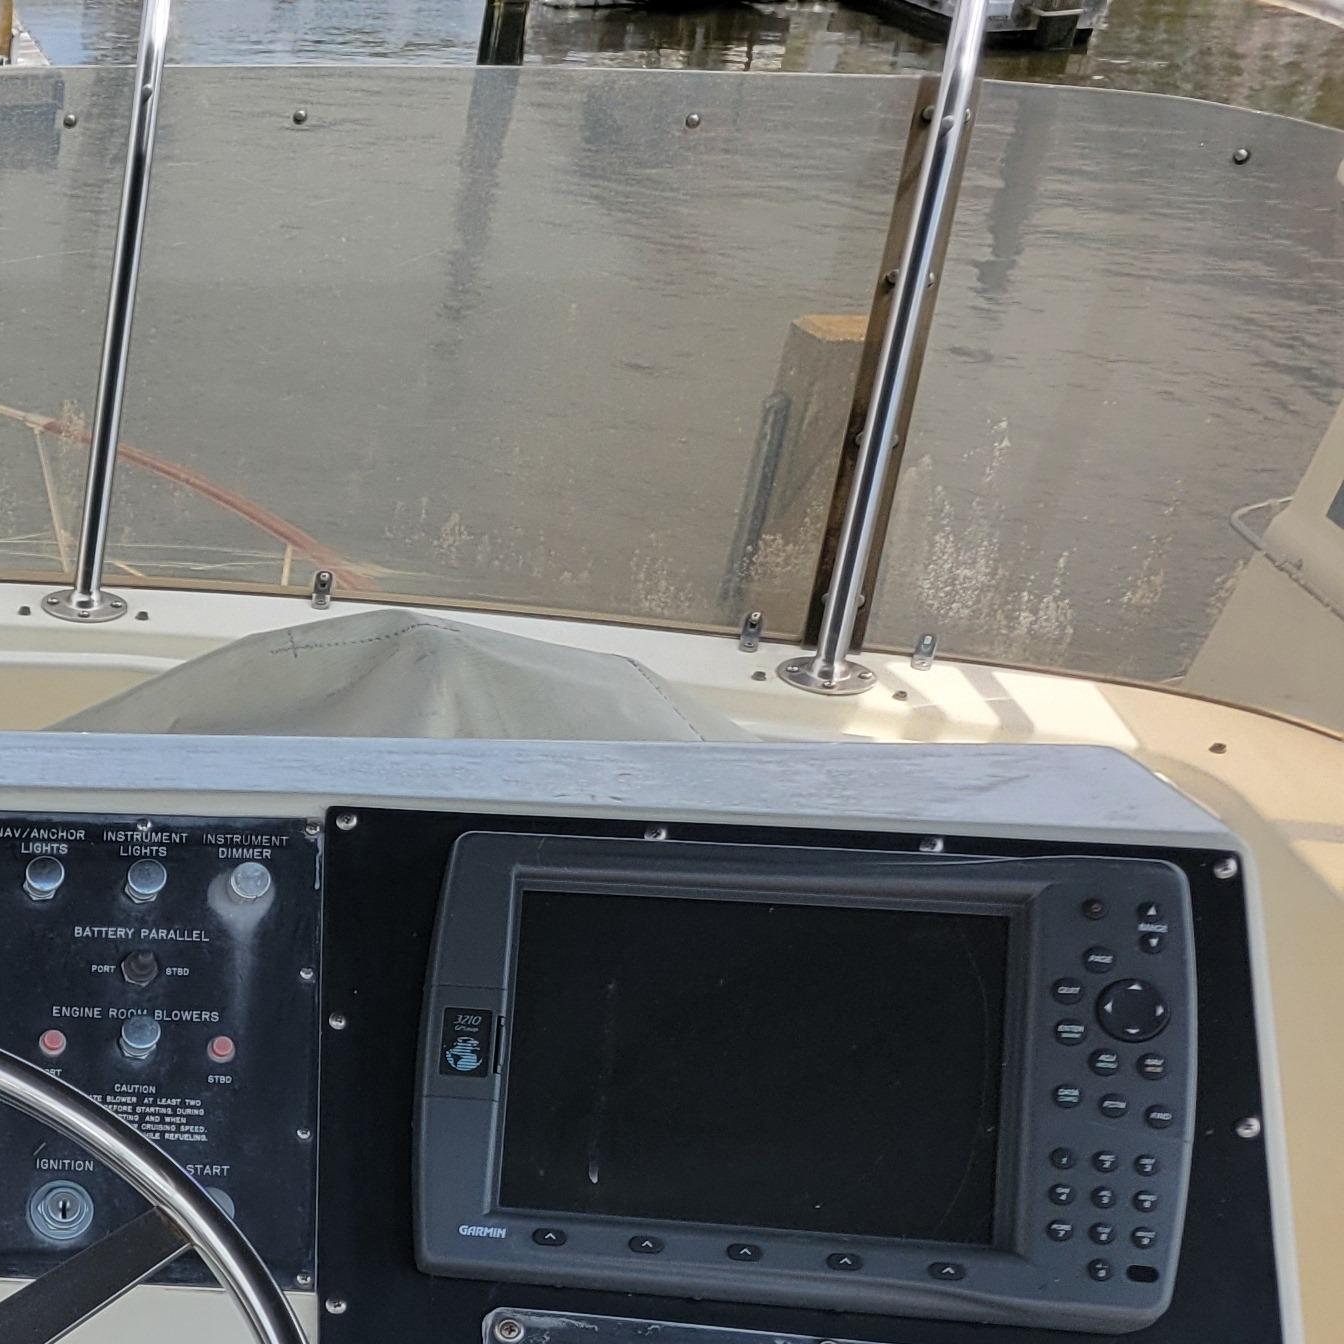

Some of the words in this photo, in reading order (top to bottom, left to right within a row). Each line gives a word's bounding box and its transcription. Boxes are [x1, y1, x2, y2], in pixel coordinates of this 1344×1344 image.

[103, 831, 188, 844] INSTRUMENT
[203, 833, 289, 847] INSTRUMENT
[21, 842, 68, 855] LIGHTS
[119, 845, 167, 858] LIGHTS
[218, 847, 272, 860] DIMMER
[74, 926, 135, 939] BATTERY
[140, 928, 210, 942] PARALLEL
[91, 964, 116, 974] PORT
[165, 967, 190, 976] STBD
[52, 1005, 102, 1019] ENGINE
[154, 1009, 220, 1023] BLOWERS
[207, 1075, 233, 1084] STBD
[114, 1083, 156, 1094] CAUTION
[106, 1095, 137, 1104] BLOWER
[143, 1097, 154, 1105] AT
[156, 1098, 181, 1106] LEAST
[185, 1099, 202, 1107] TWO
[176, 1107, 205, 1116] DURING
[144, 1115, 161, 1123] AND
[164, 1116, 187, 1124] WHEN
[36, 1158, 94, 1172] IGNITION
[185, 1164, 230, 1177] START
[458, 1224, 507, 1239] GARMIN
